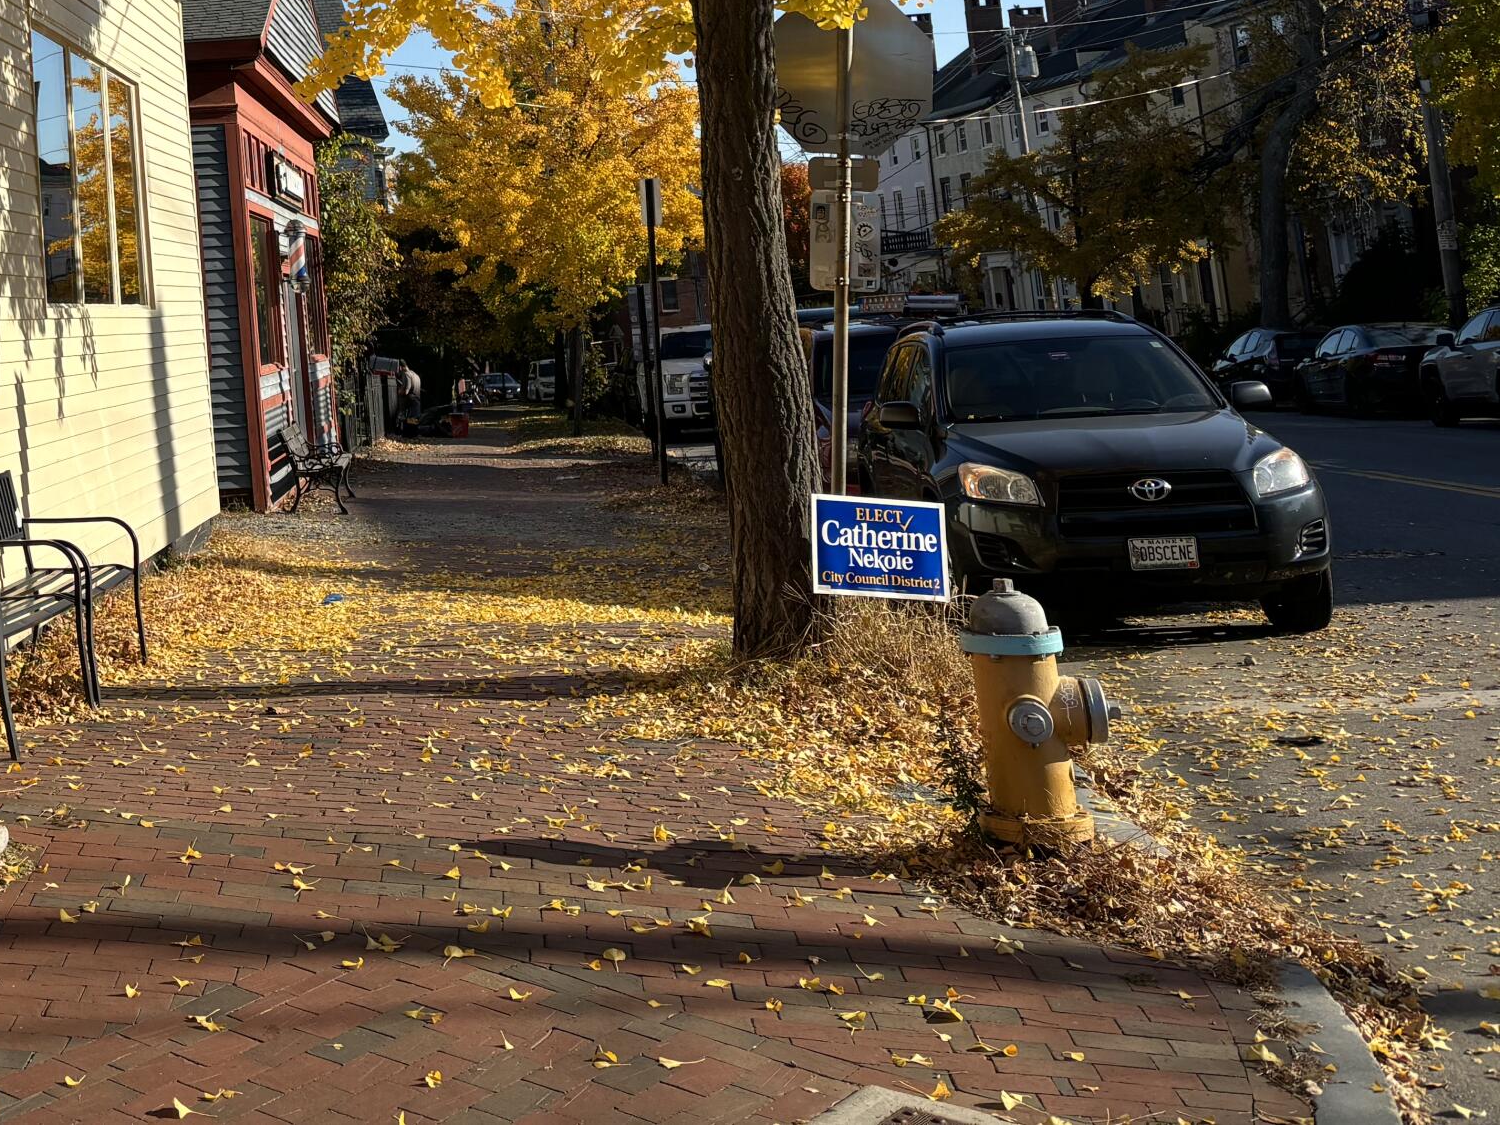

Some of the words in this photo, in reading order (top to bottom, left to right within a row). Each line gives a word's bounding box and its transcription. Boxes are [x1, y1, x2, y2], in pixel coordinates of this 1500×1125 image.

[855, 507, 903, 524] ELECT
[821, 519, 938, 553] Catherine
[848, 547, 914, 573] Nekoie
[1140, 544, 1195, 562] OBSCENE
[822, 570, 844, 586] City
[845, 571, 889, 587] Council
[891, 574, 933, 589] District
[934, 578, 941, 589] 2
